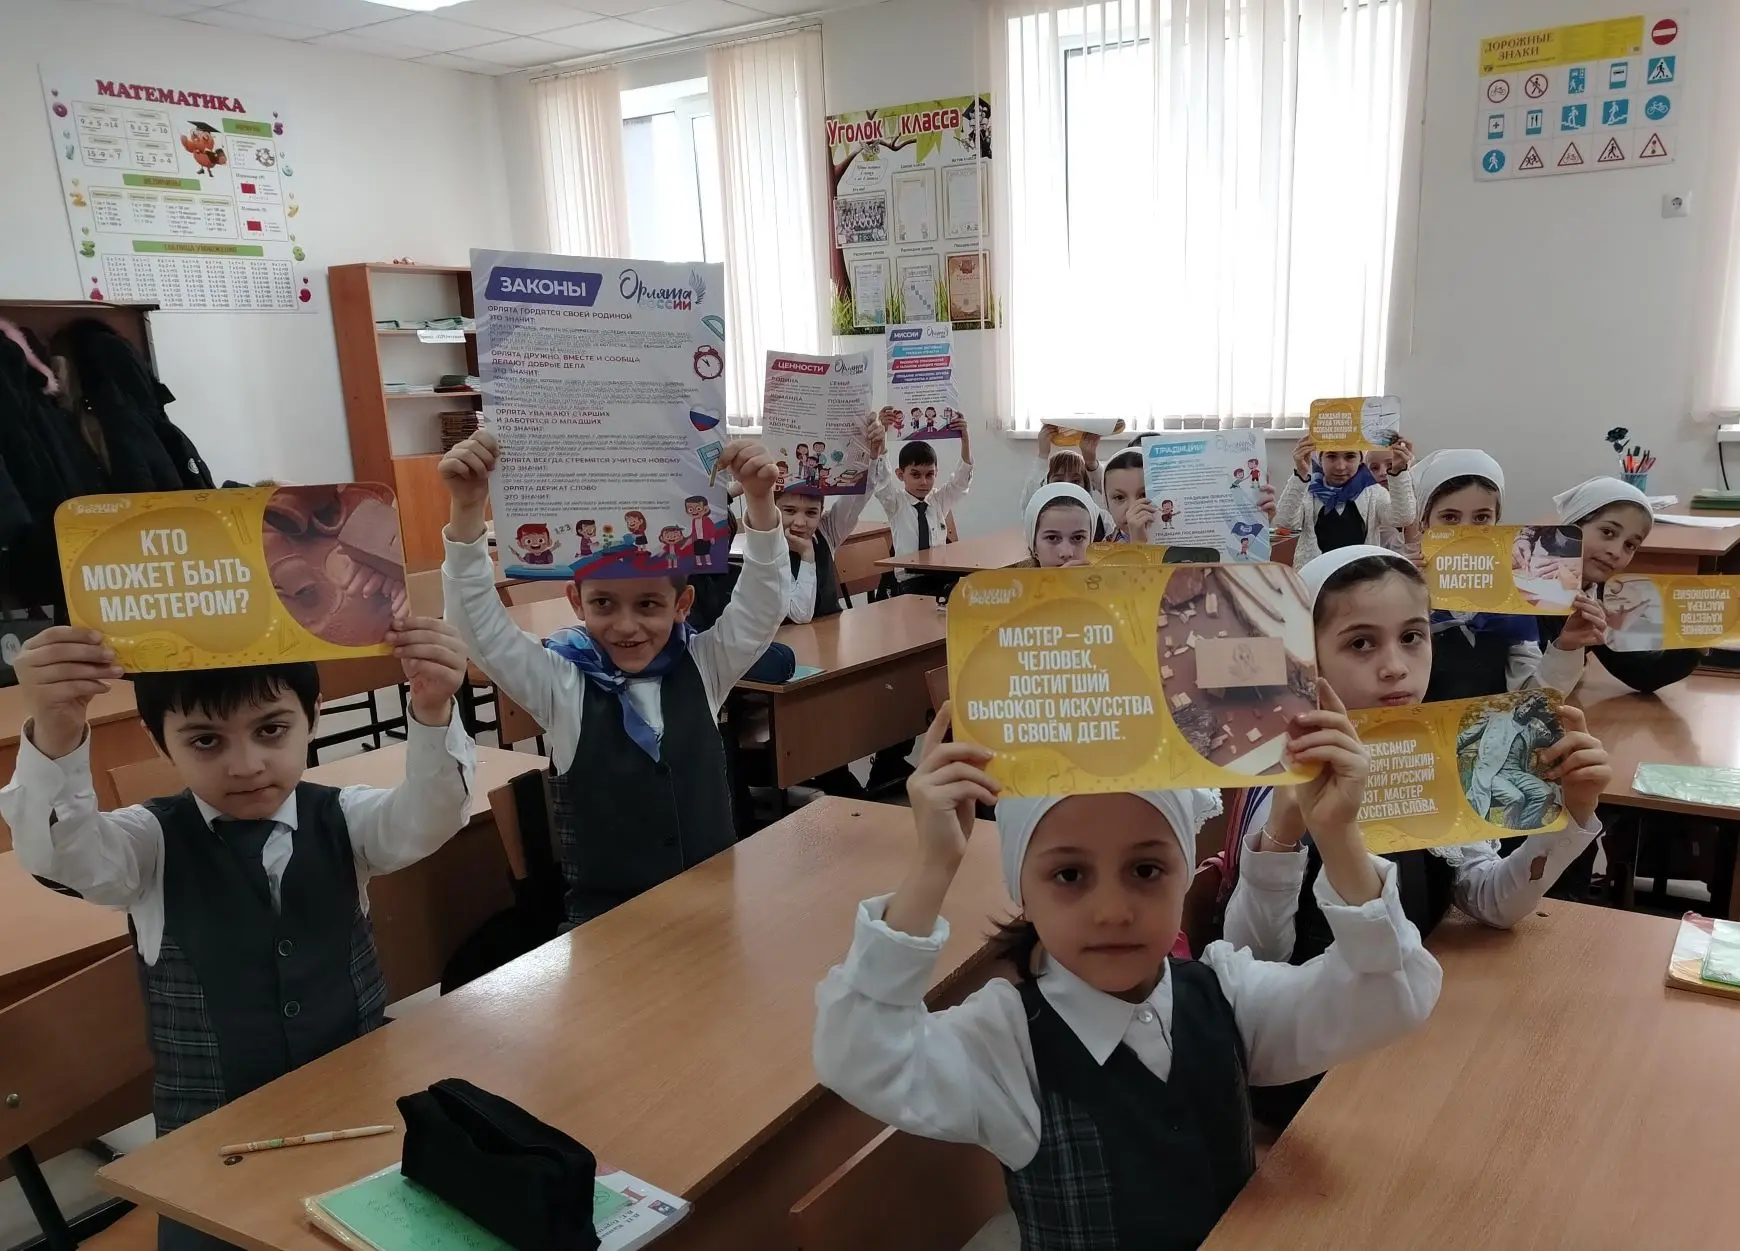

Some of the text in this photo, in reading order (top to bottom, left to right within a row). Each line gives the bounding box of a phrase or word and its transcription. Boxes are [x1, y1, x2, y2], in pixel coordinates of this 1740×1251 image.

[1498, 46, 1540, 60] ЗНАКИ
[96, 79, 247, 113] МАТЕМАТИКА
[500, 276, 587, 297] ЗАКОНЫ
[618, 268, 692, 304] Орлята
[487, 305, 632, 321] ОРЛЯТА ГОРДЯТСЯ СВОЕЙ РОДИНОЙ
[894, 331, 919, 339] МИССИИ
[491, 350, 522, 358] ОРЛЯТА
[562, 354, 595, 362] ВМЕСТЕ
[604, 355, 641, 364] СООБЩА
[491, 358, 586, 369] ДЕЛАЮТ ДОБРЫЕ ДЕЛА
[778, 361, 825, 373] ЦЕННОСТИ
[771, 376, 799, 384] РОДИНА
[495, 408, 527, 416] ОРЛЯТА
[528, 409, 570, 417] УВАЖАЮТ
[504, 417, 550, 425] ЗАБОТЯТСЯ
[559, 418, 602, 426] МЛАДШИХ
[611, 457, 647, 465] УЧИТЬСЯ
[140, 528, 189, 558] КТО
[1435, 553, 1500, 571] ОРЛЁНОК-
[81, 556, 251, 593] МОЖЕТ БЫТЬ
[1438, 573, 1494, 590] МАСТЕР!
[99, 588, 250, 624] МАСТЕРОМ?
[1687, 600, 1725, 611] МАСТЕРА
[998, 626, 1062, 649] МАСТЕР
[1083, 624, 1114, 647] ЭТО
[1018, 647, 1097, 673] ЧЕЛОВЕК,
[1008, 668, 1110, 698] ДОСТИГШИЙ
[967, 695, 1154, 722] ВЫСОКОГО ИСКУССТВА
[1003, 717, 1127, 745] В СВОЁМ ДЕЛЕ.
[1366, 739, 1417, 757] ЕКСАНДР
[1369, 752, 1435, 773] ВИЧ ПУШКИН
[1367, 765, 1435, 788] КИЙ РУССКИЙ
[1384, 784, 1424, 802] МАСТЕР
[1401, 797, 1439, 815] СЛОВА.
